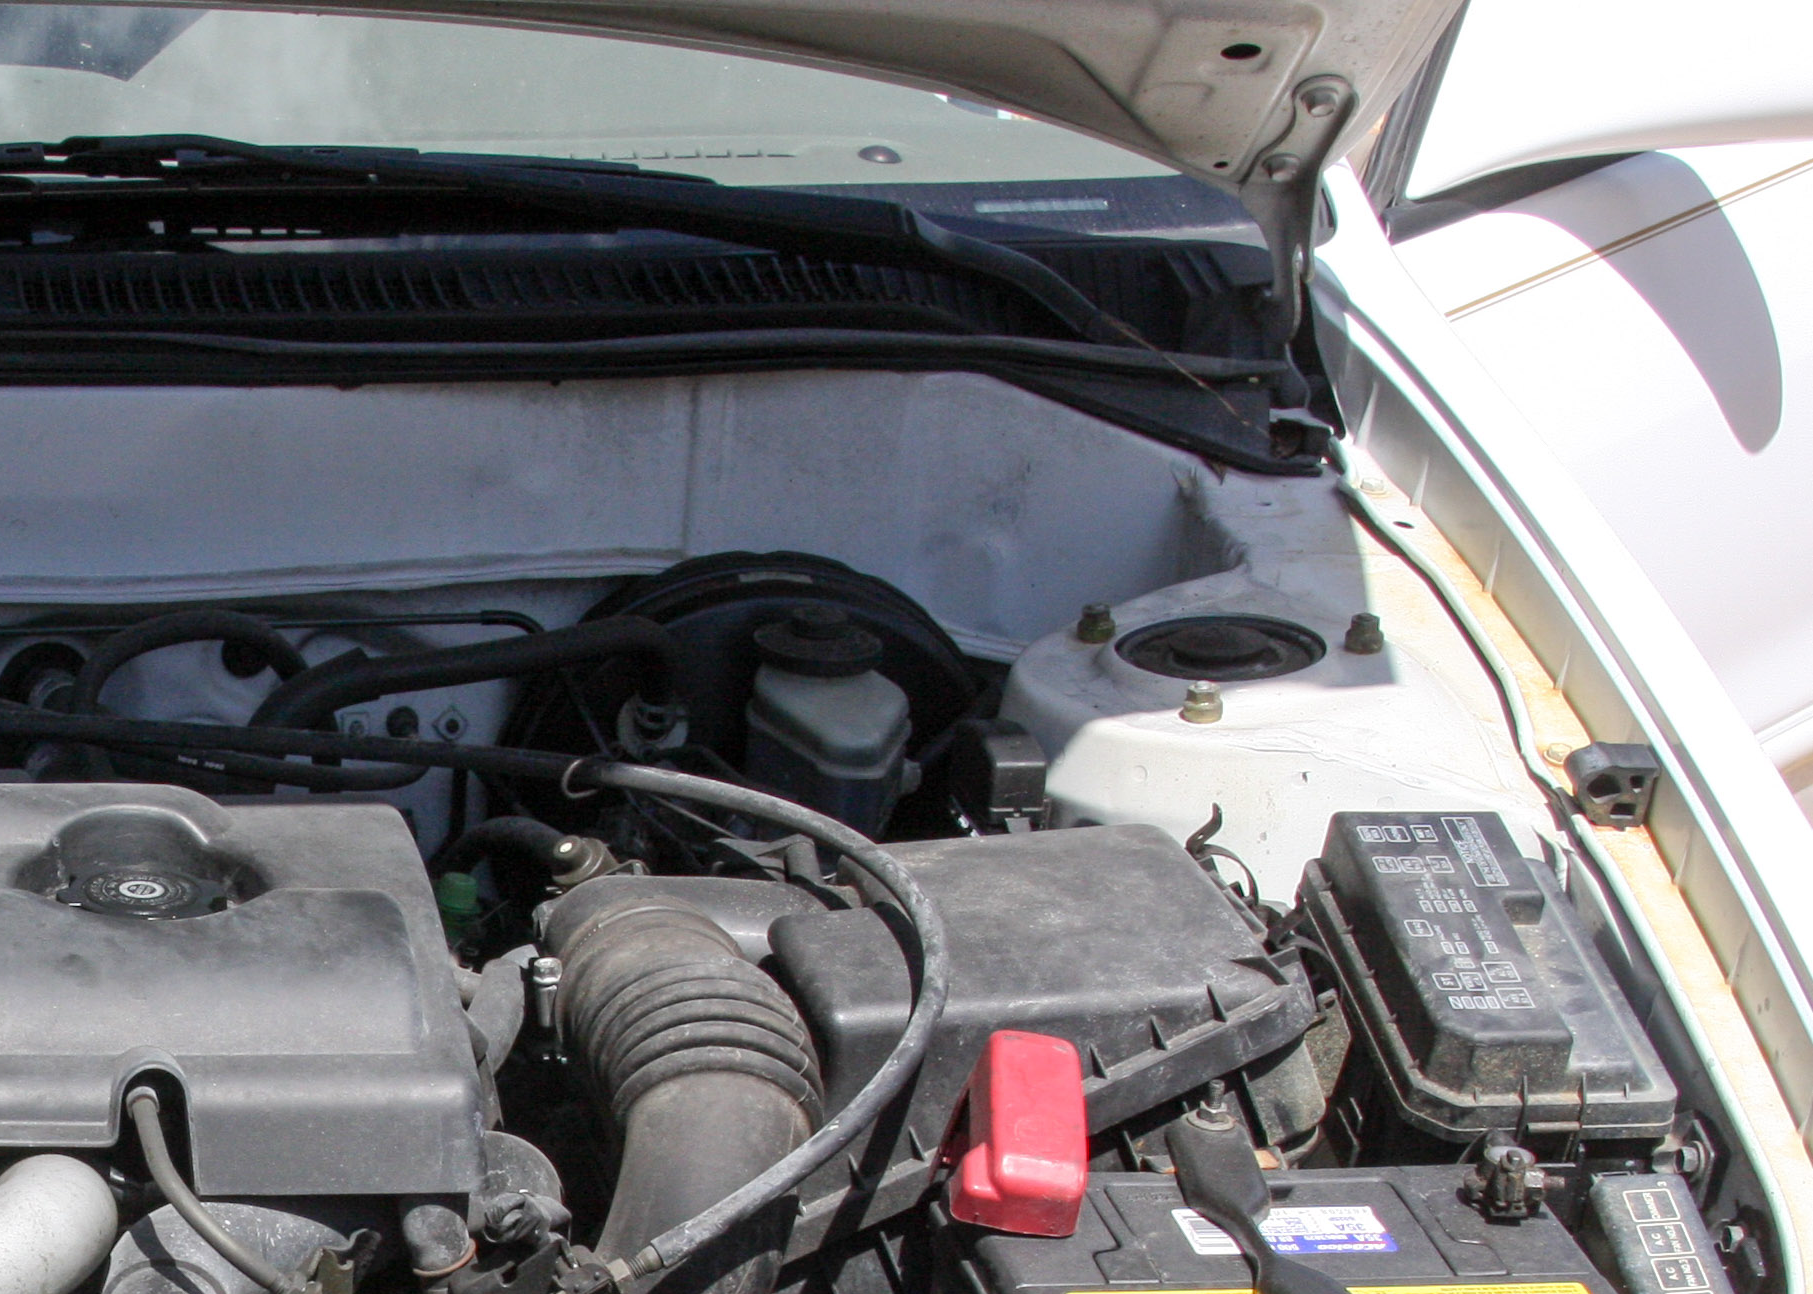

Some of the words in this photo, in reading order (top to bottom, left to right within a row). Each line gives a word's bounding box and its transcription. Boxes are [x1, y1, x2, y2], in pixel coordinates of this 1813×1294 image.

[1657, 1180, 1667, 1188] 3
[1642, 1192, 1661, 1220] DIMMER
[1334, 1223, 1366, 1232] 35A
[1353, 1233, 1383, 1242] 35A
[1317, 1243, 1386, 1251] ACDelco
[1671, 1239, 1683, 1254] FAN
[1685, 1274, 1698, 1287] FAN
